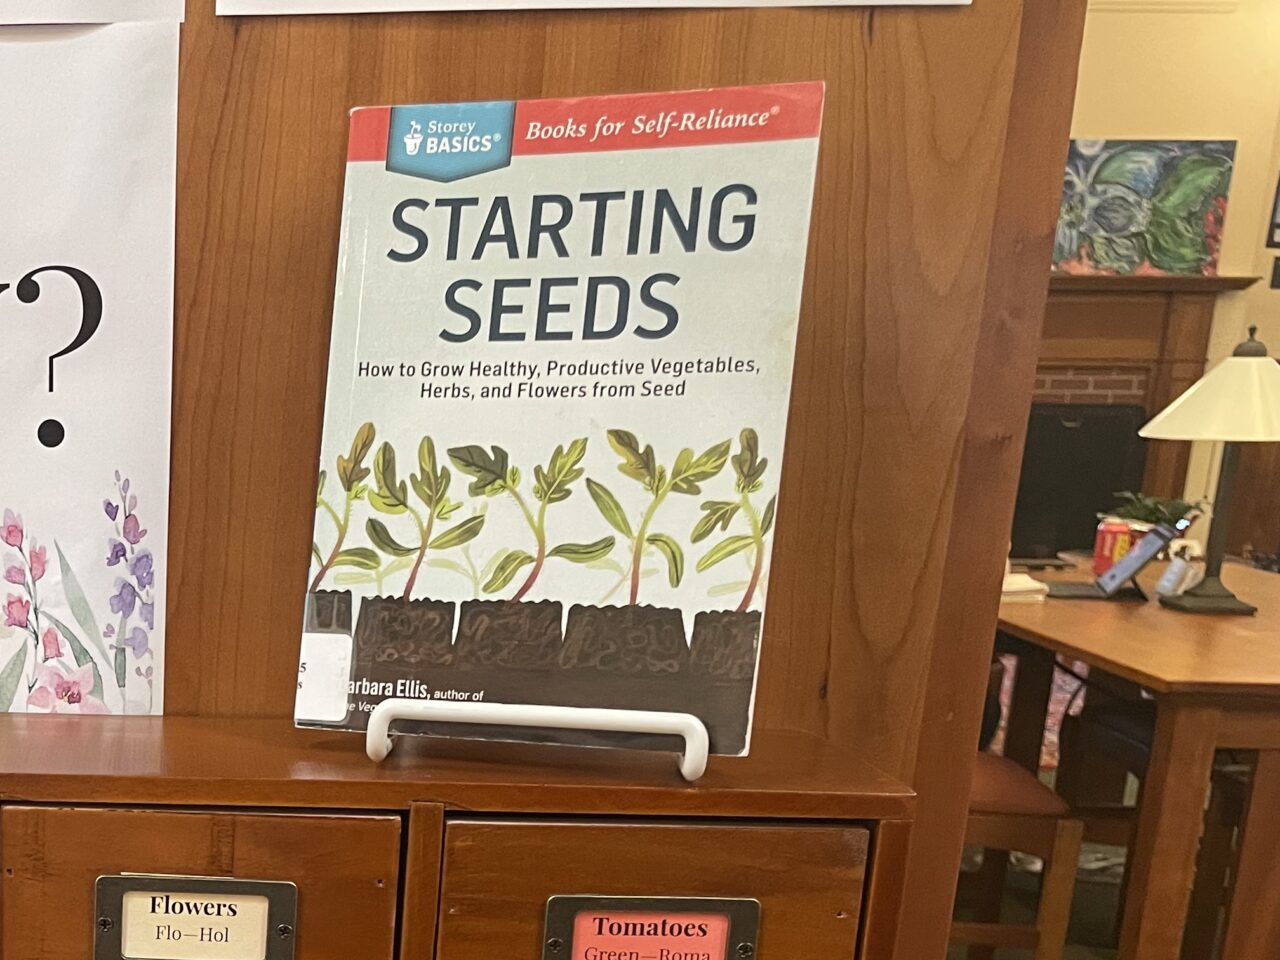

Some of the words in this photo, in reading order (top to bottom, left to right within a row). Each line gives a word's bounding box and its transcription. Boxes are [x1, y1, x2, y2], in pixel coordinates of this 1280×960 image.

[427, 120, 476, 135] Storey
[525, 117, 587, 140] Books
[589, 116, 625, 142] for
[386, 183, 758, 263] STARTING
[438, 272, 681, 343] SEEDS
[358, 361, 394, 377] How
[399, 362, 416, 377] to
[420, 361, 465, 377] Grow
[469, 360, 541, 380] Healthy,
[546, 358, 645, 377] Productive
[650, 356, 761, 378] Vegetables,
[420, 382, 475, 400] Herbs,
[480, 382, 512, 399] and
[517, 381, 587, 398] Flowers
[592, 381, 635, 398] from
[640, 379, 686, 397] Seed
[347, 677, 393, 697] arbara
[396, 679, 431, 700] Ellis,
[433, 688, 470, 700] author
[472, 690, 484, 702] of
[149, 895, 238, 917] Flowers
[592, 917, 709, 937] Tomatoes
